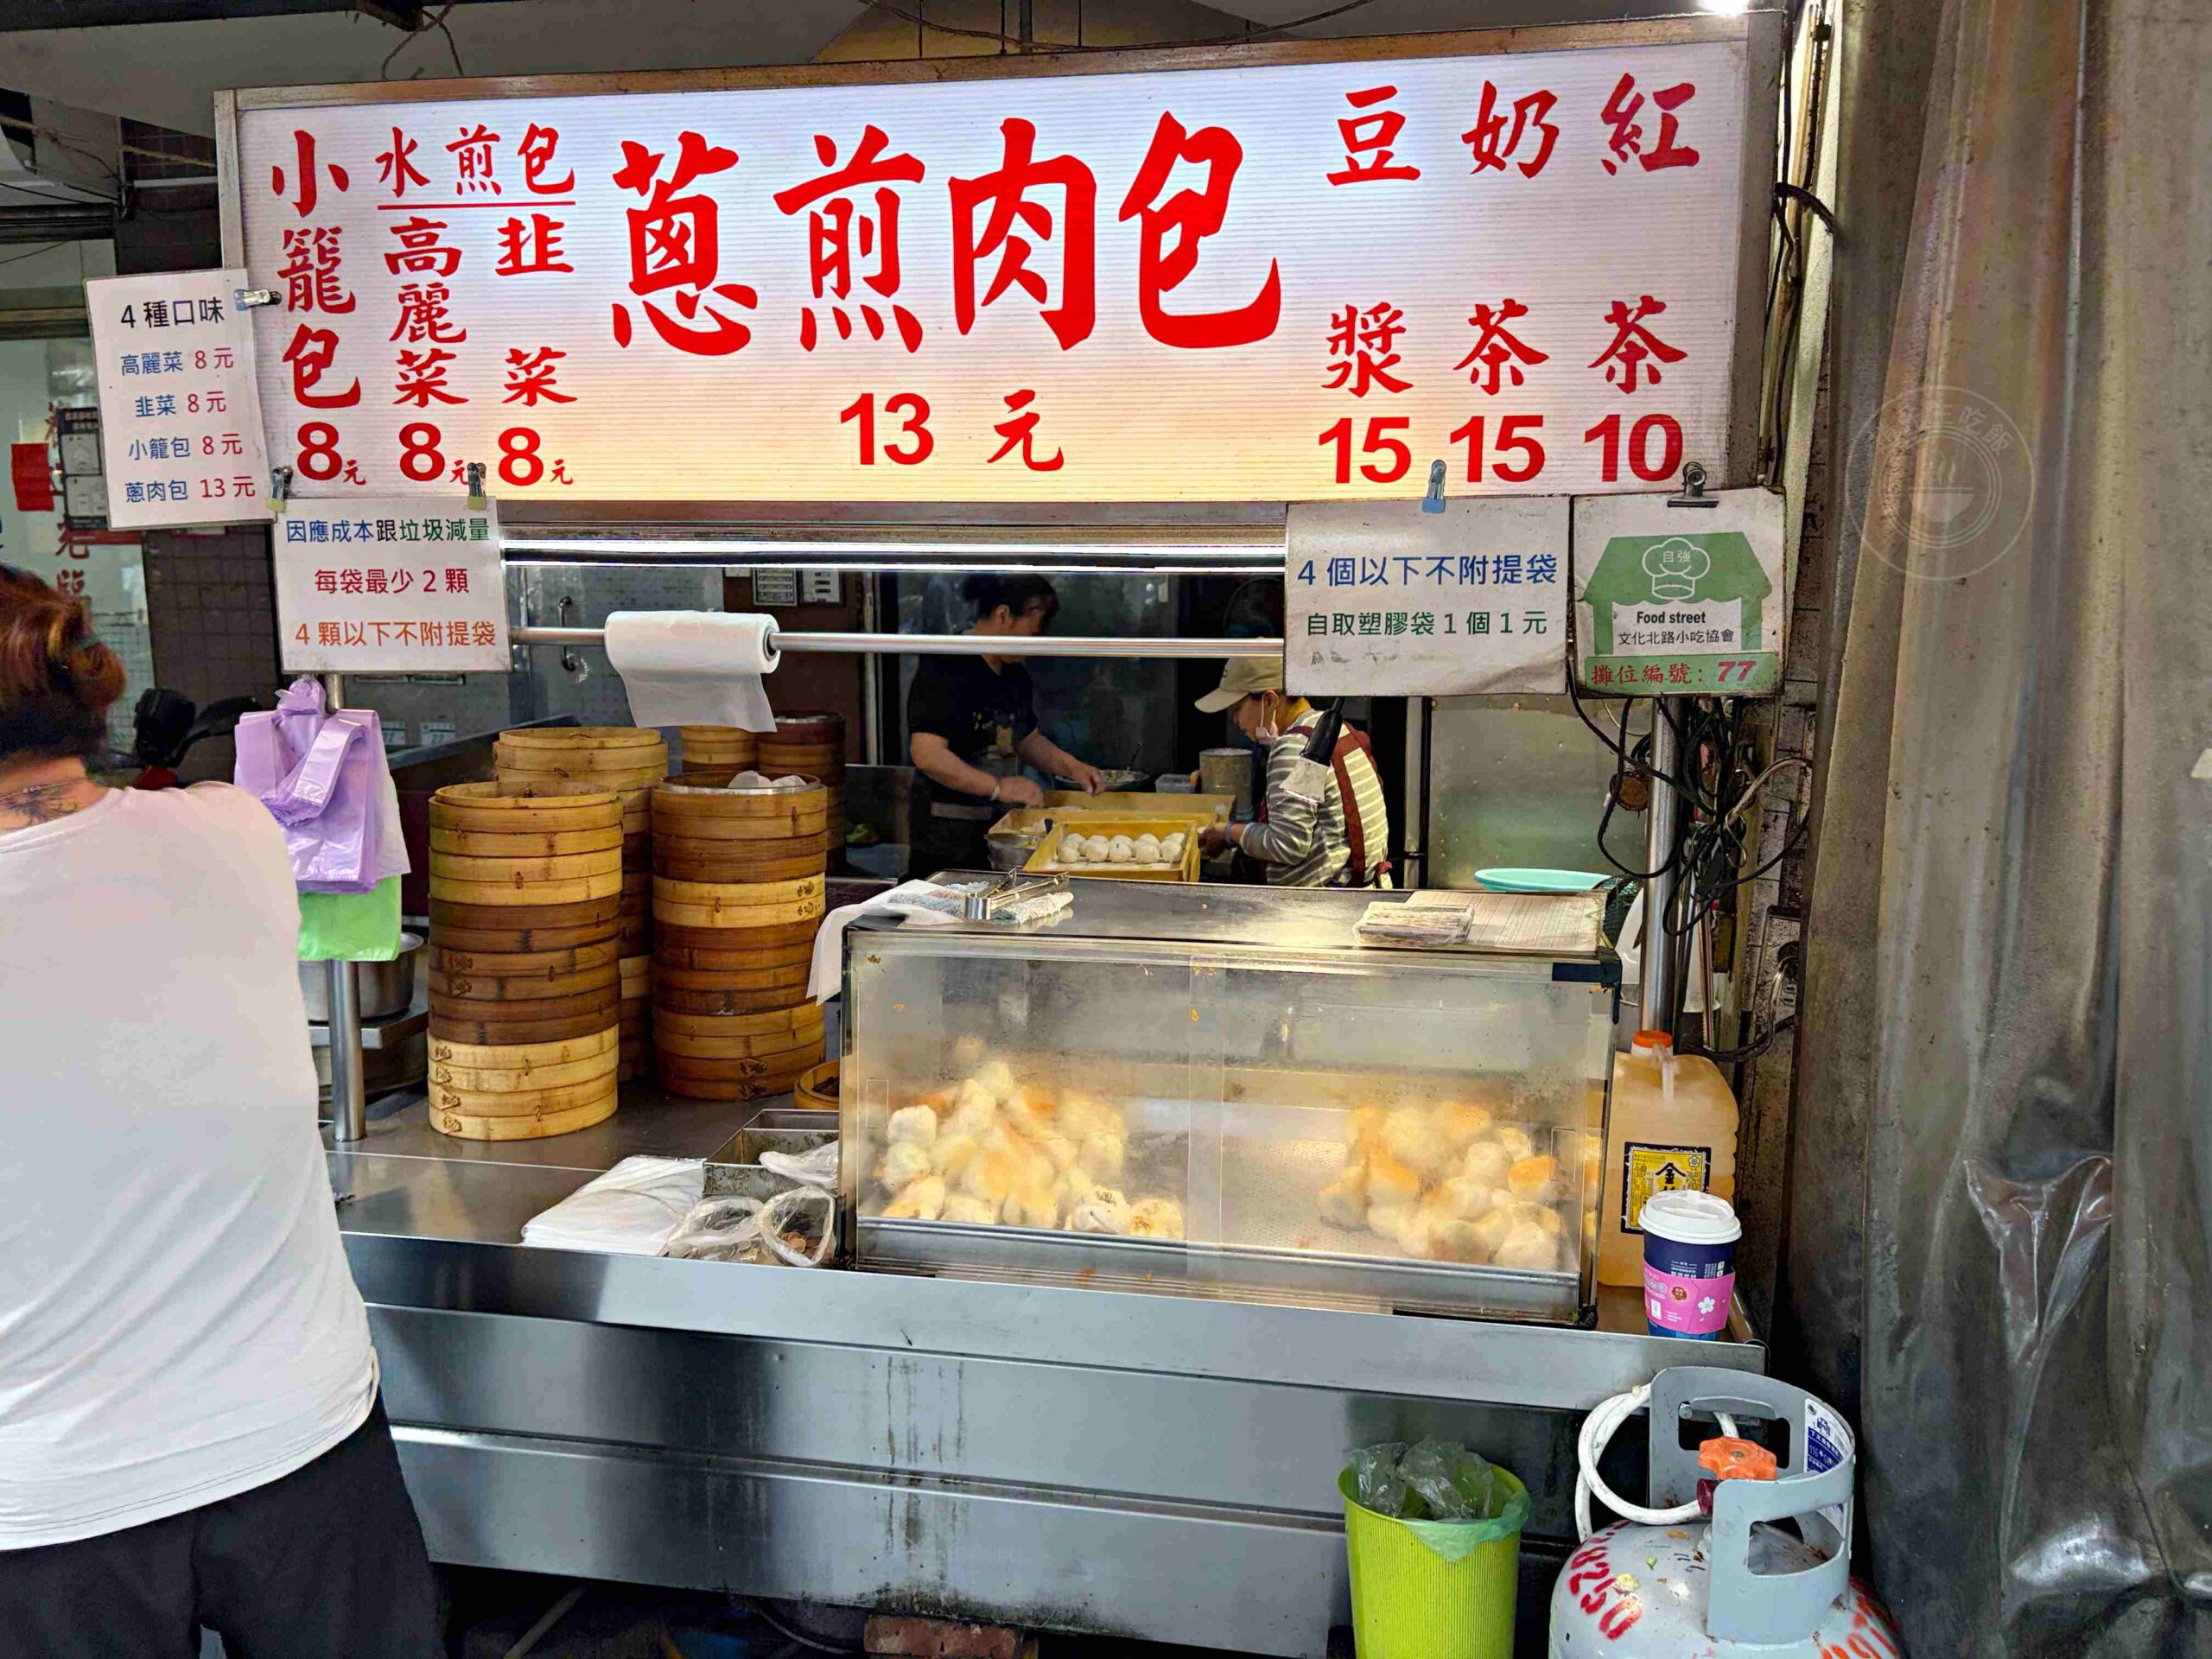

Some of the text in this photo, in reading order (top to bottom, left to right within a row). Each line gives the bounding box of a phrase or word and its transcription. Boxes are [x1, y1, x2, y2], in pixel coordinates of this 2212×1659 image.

[375, 123, 575, 197] 水煎包
[612, 110, 1281, 356] 蔥煎肉包
[1320, 85, 1421, 398] 豆漿
[1452, 79, 1560, 397] 奶茶
[1587, 73, 1700, 395] 紅茶
[272, 129, 361, 410] 小籠包
[120, 296, 226, 329] 4種口味
[384, 216, 469, 409] 高麗菜
[495, 213, 579, 409] 韭菜
[120, 350, 183, 377] 高麗菜
[135, 395, 177, 418] 韭菜
[128, 436, 191, 461] 小籠包
[1318, 416, 1413, 485] 15
[1449, 414, 1547, 484] 15
[1583, 413, 1684, 483] 10
[286, 518, 491, 543] 因應成本跟垃圾減量
[1663, 550, 1691, 563] 自強
[1618, 629, 1734, 646] 文化北路小吃協會
[1637, 610, 1707, 624] Food street
[1717, 660, 1757, 683] 77
